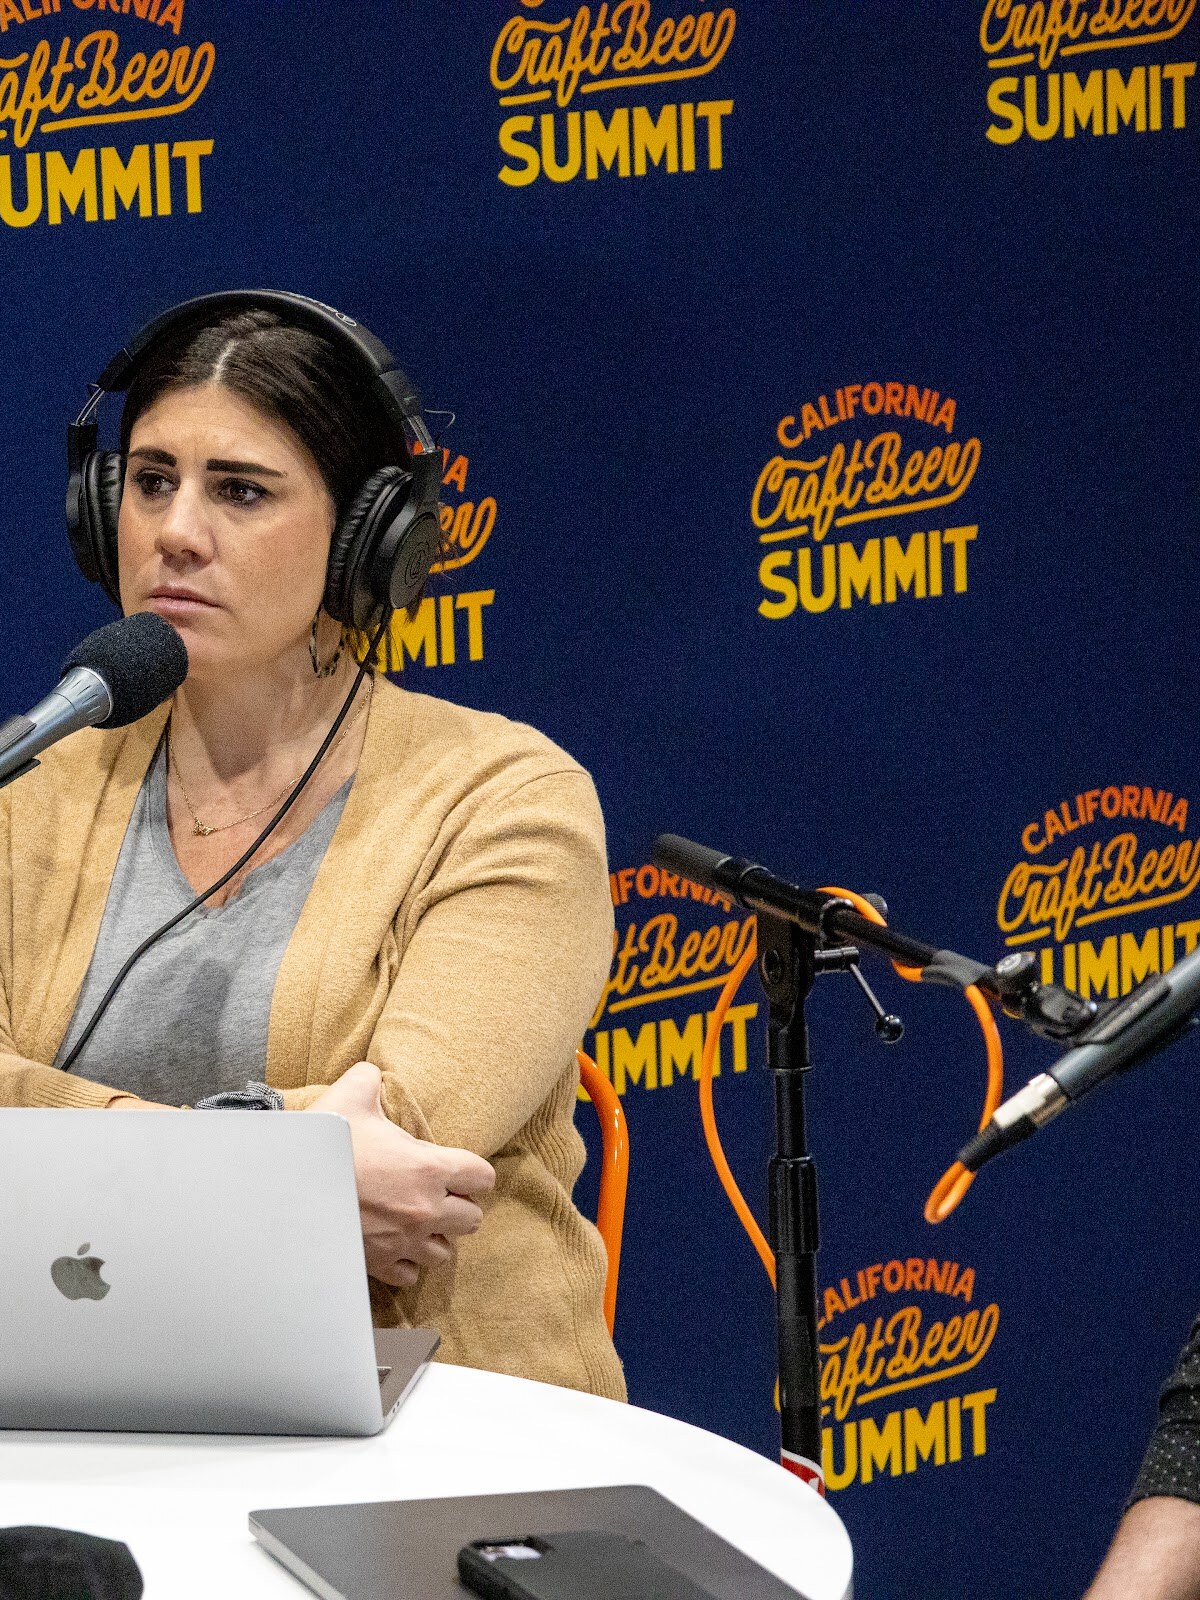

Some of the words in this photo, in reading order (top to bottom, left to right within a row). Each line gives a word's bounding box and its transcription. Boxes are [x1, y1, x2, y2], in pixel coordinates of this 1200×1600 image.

[74, 29, 216, 118] Beer
[489, 3, 611, 107] Craft
[611, 0, 736, 80] Beer
[498, 100, 734, 187] SUMMIT
[985, 61, 1197, 145] SUMMIT
[776, 381, 957, 449] CALIFORNIA
[751, 439, 864, 542] Craft
[864, 431, 981, 508] Beer
[757, 524, 978, 620] SUMMIT
[1021, 784, 1189, 854] CALIFORNIA
[997, 841, 1102, 942] Craft
[1102, 832, 1200, 906] Beer
[637, 912, 757, 992] Beer
[1030, 919, 1200, 1000] UMMIT
[817, 1258, 976, 1331] ALIFORNIA
[885, 1303, 999, 1382] Beer
[820, 1388, 997, 1491] UMMIT
